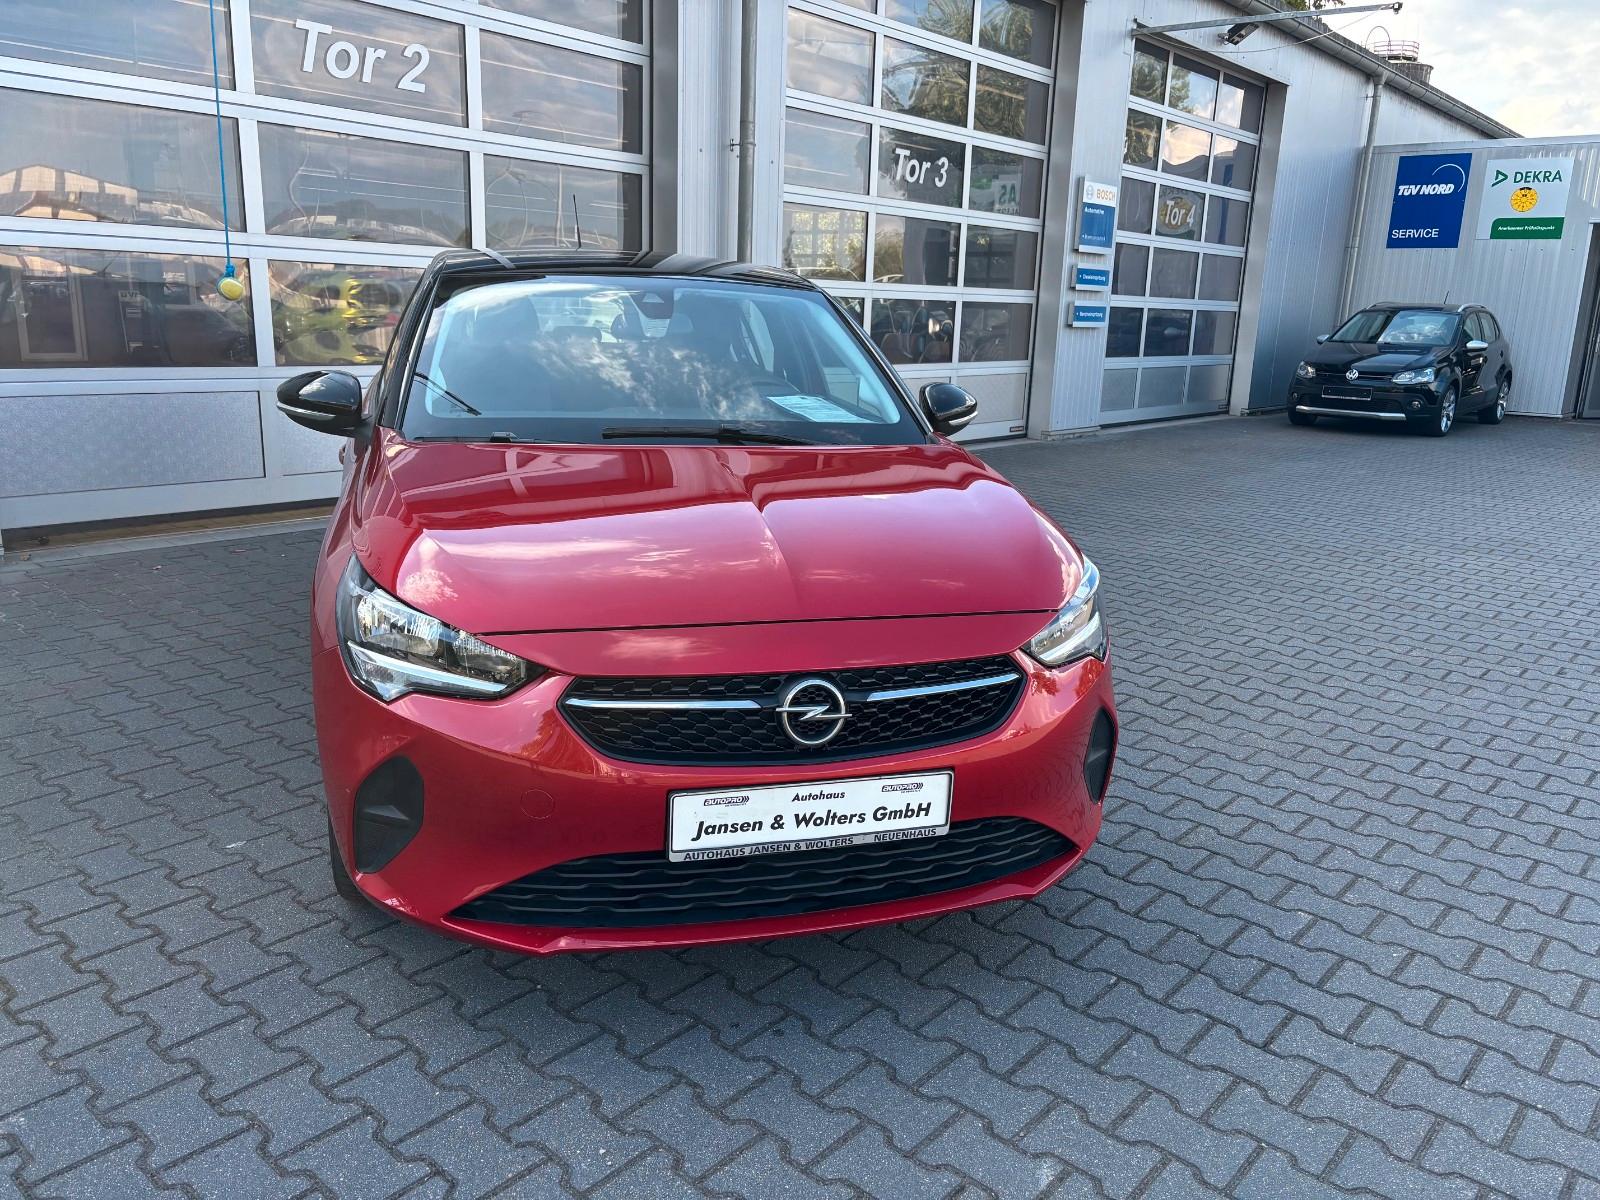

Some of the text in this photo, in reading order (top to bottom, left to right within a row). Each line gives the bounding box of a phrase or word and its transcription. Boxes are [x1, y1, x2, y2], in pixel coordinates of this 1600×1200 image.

[295, 18, 430, 94] Tor 2
[895, 147, 949, 188] Tor 3
[1513, 169, 1563, 184] DEKRA
[1096, 188, 1116, 201] BOSCH
[1397, 183, 1455, 196] TÜV NORD
[1165, 200, 1196, 227] Tor 4
[1391, 228, 1440, 239] SERVICE
[704, 796, 744, 806] AUTOPRO
[792, 790, 846, 803] Autohaus
[691, 802, 932, 842] Jansen & Wolters GmbH
[684, 828, 937, 861] AUTOHAUS JANSEN & WOLTERS NEUENHAUS
